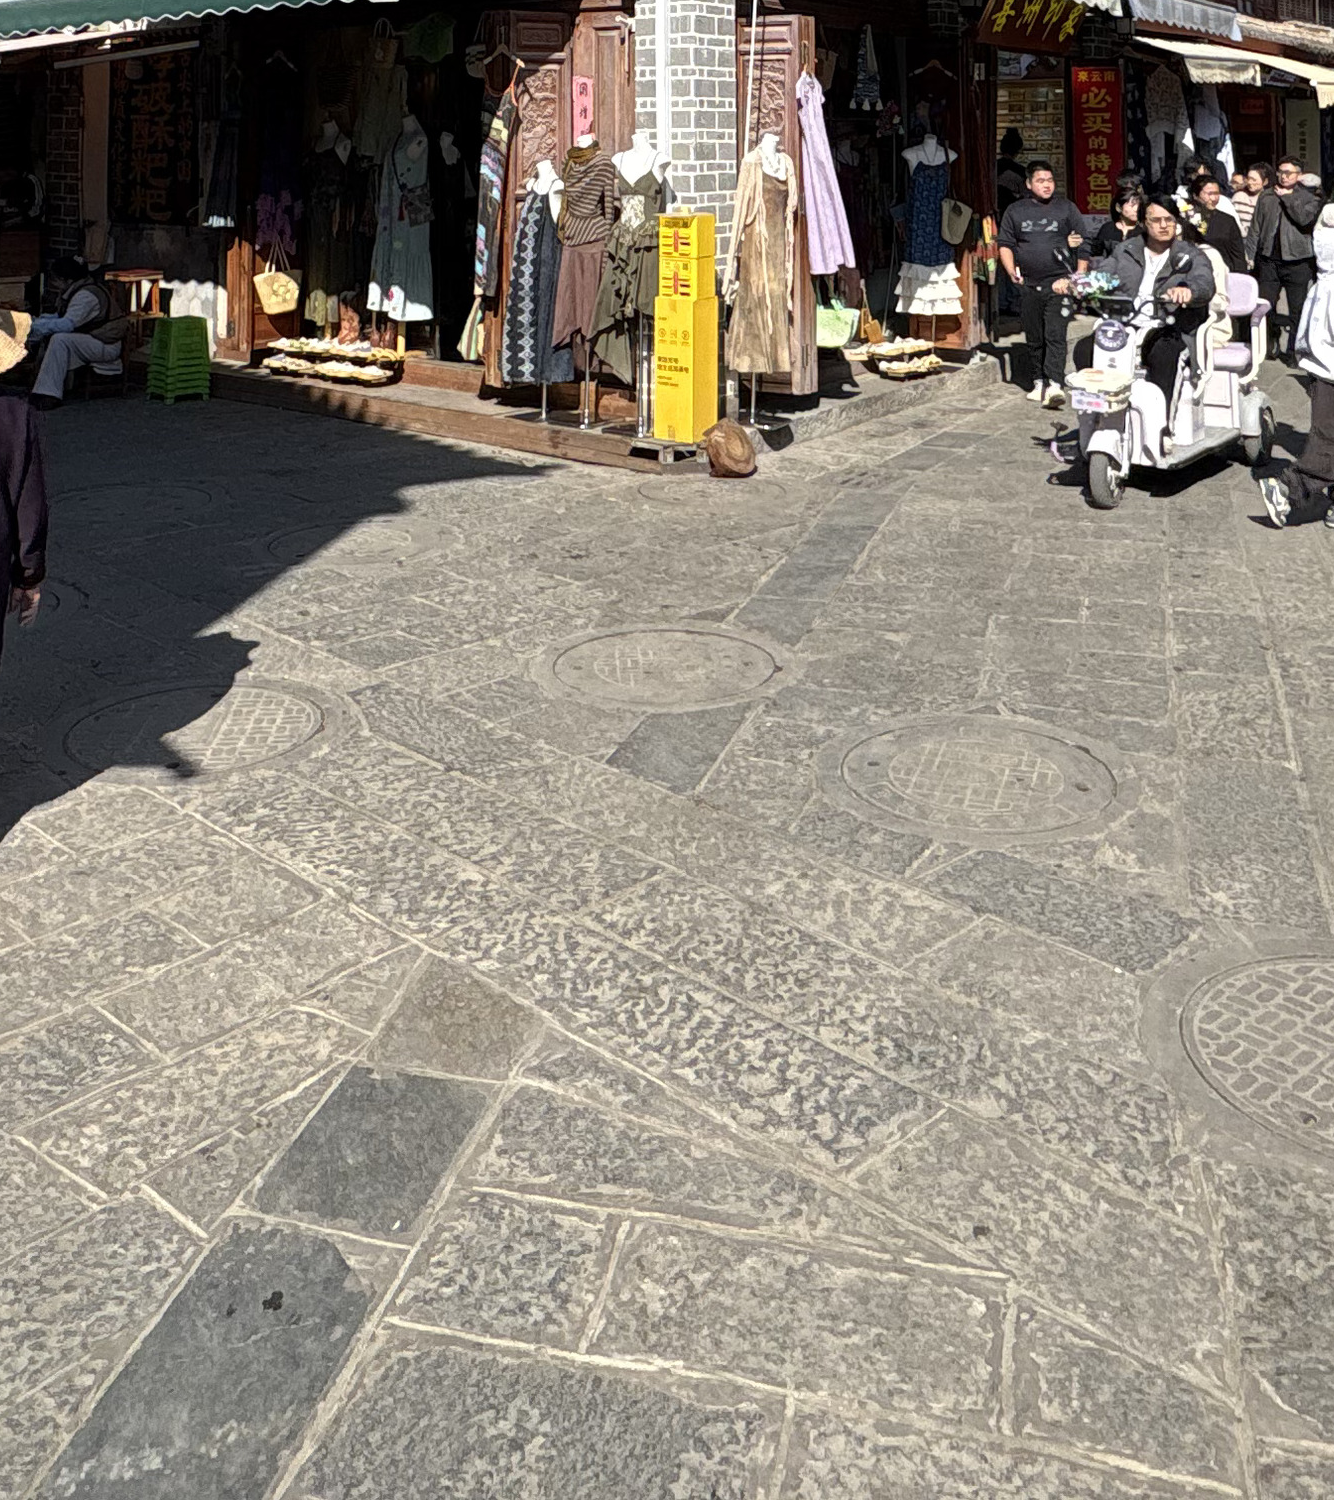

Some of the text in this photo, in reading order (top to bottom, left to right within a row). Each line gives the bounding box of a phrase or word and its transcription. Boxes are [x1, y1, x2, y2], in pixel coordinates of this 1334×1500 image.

[1081, 86, 1114, 213] 必买的特色烟
